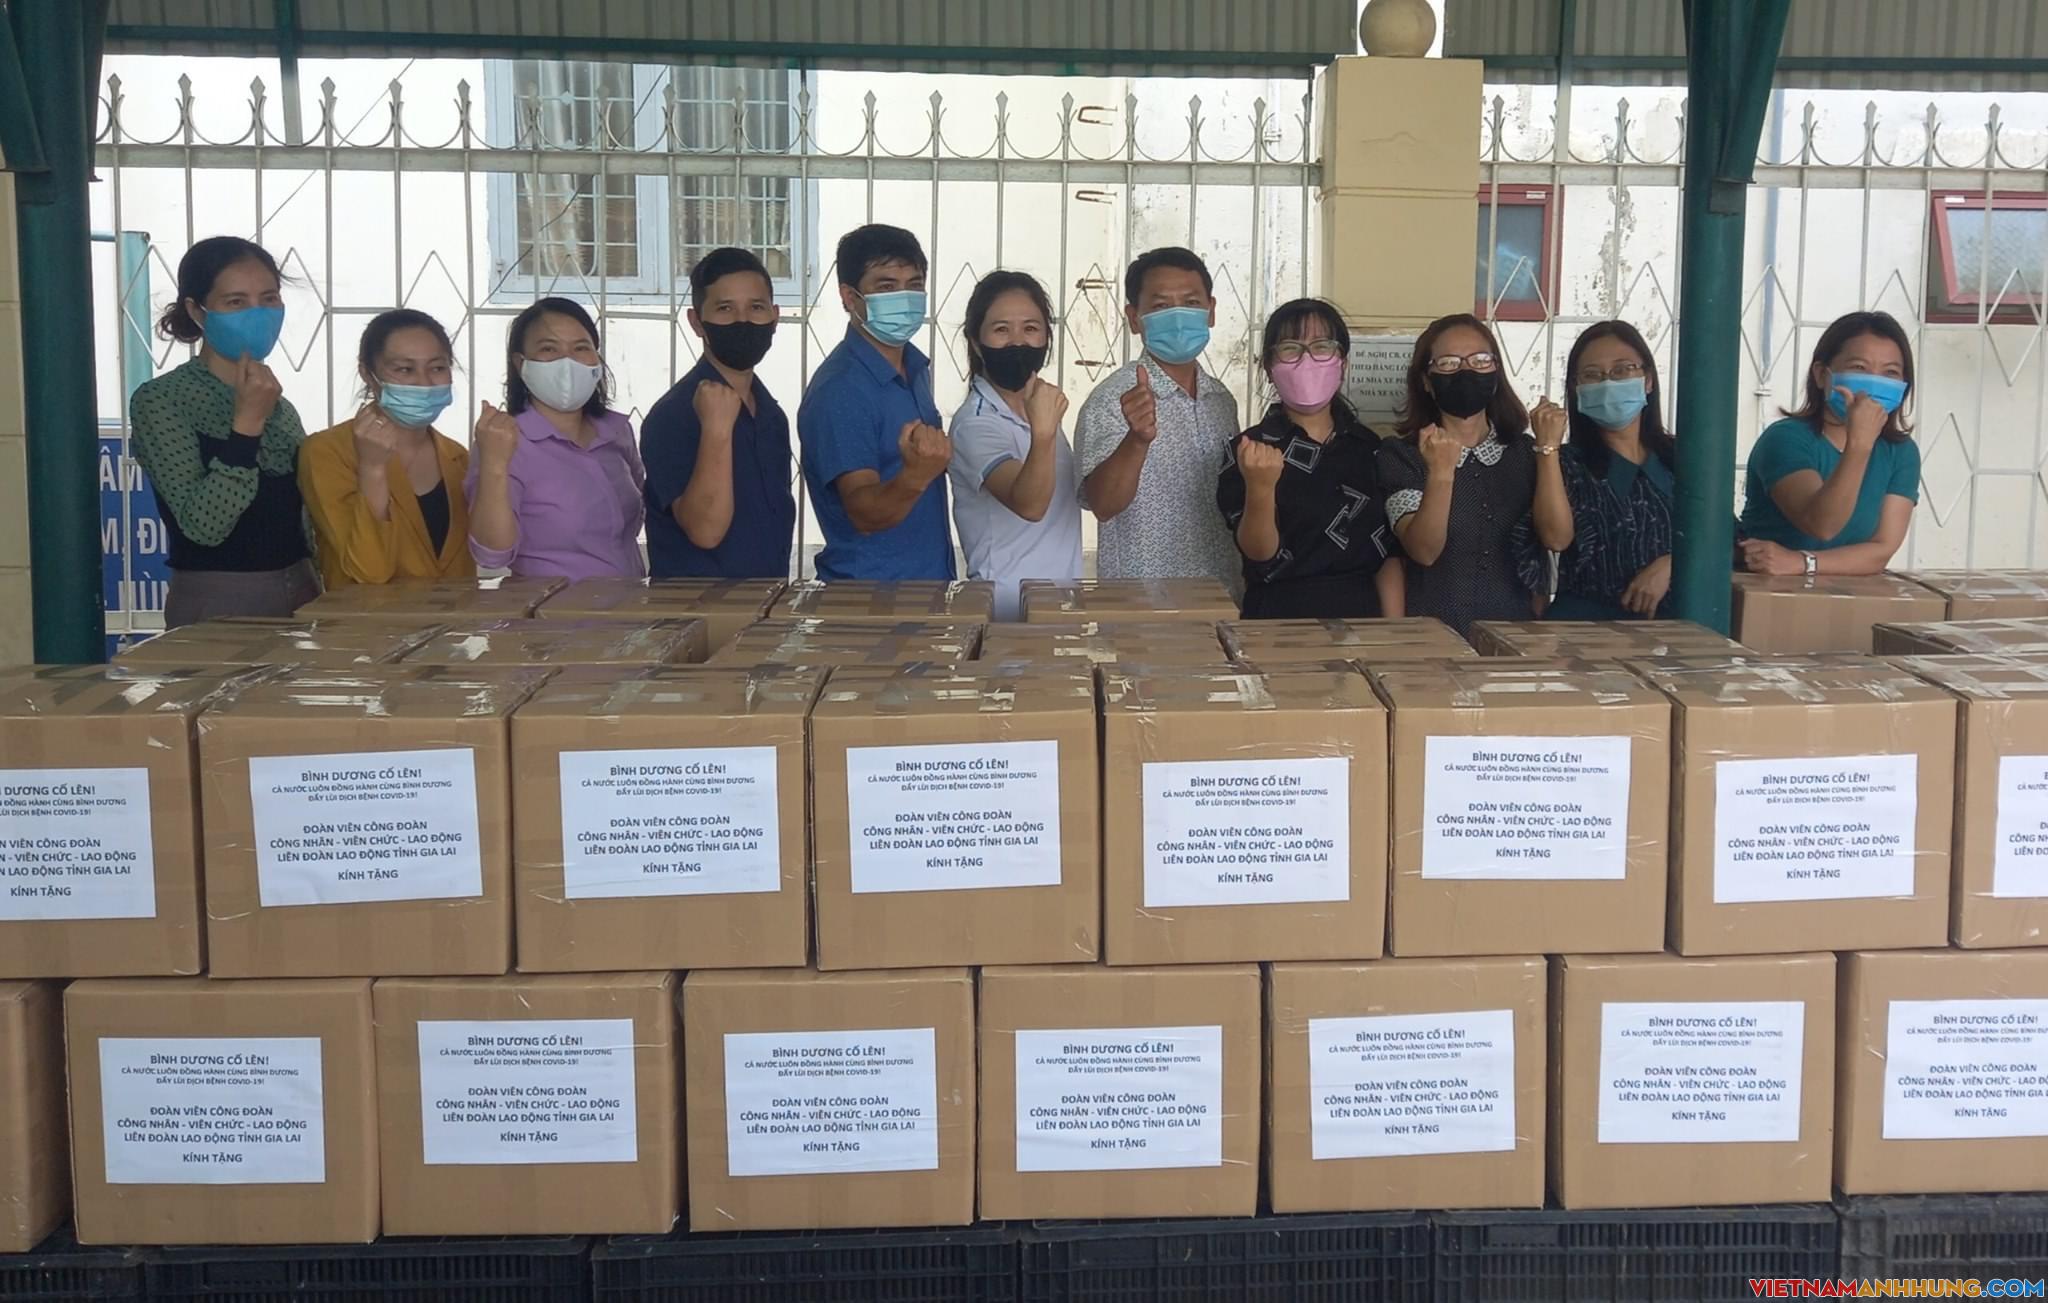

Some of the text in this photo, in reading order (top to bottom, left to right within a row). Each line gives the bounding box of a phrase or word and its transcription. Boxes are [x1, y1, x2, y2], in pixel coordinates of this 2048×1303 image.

[1472, 750, 1581, 763] BÌNH DƯƠNG CỐ LÊN!
[610, 761, 725, 775] BÌNH DƯƠNG CỐ LÊN!
[896, 756, 1008, 771] BÌNH DƯƠNG CỐ LÊN!
[301, 766, 421, 780] BÌNH DƯƠNG CỐ LÊN!
[1762, 770, 1869, 784] BÌNH DƯƠNG CỐ LÊN!
[1190, 773, 1300, 787] BÌNH DƯƠNG CỐ LÊN!
[4, 782, 96, 796] DƯƠNG CỐ LÊN!
[303, 818, 427, 833] ĐOÀN VIÊN CÔNG ĐOÀN
[269, 836, 300, 848] CÔNG
[302, 835, 333, 847] NHÂN
[341, 834, 366, 845] VIÊN
[368, 833, 399, 845] CHỨC
[407, 834, 428, 843] LAO
[430, 831, 461, 845] ĐỘNG
[2009, 833, 2036, 843] CÔNG
[277, 846, 455, 861] LIÊN ĐOÀN LAO ĐỘNG TỈNH GIA LAI
[1495, 846, 1550, 859] KÍNH TẶNG
[2014, 846, 2034, 856] LIÊN
[642, 860, 701, 874] KÍNH TẶNG
[926, 855, 982, 868] KÍNH TẶNG
[337, 867, 398, 881] KÍNH TẶNG
[1218, 870, 1273, 884] KÍNH TẶNG
[1786, 867, 1840, 880] KÍNH TẶNG
[10, 885, 72, 897] KÍNH TẶNG
[1648, 1014, 1756, 1027] BÌNH DƯƠNG CỐ LÊN!
[1933, 1013, 2038, 1024] BÌNH DƯƠNG CỐ LÊN!
[467, 1033, 582, 1046] BÌNH DƯƠNG CỐ LÊN!
[1356, 1027, 1464, 1041] BÌNH DƯƠNG CỐ LÊN!
[772, 1043, 885, 1057] BÌNH DƯƠNG CỐ LÊN!
[1063, 1040, 1173, 1053] BÌNH DƯƠNG CỐ LÊN!
[150, 1051, 268, 1065] BÌNH DƯƠNG CỐ LÊN!
[1671, 1109, 1725, 1121] KÍNH TẶNG
[1954, 1106, 2008, 1119] KÍNH TẶNG
[1384, 1122, 1439, 1135] KÍNH TẶNG
[500, 1130, 557, 1143] KÍNH TẶNG
[1091, 1137, 1146, 1149] KÍNH TẶNG
[803, 1140, 859, 1153] KÍNH TẶNG
[182, 1151, 242, 1164] KÍNH TẶNG
